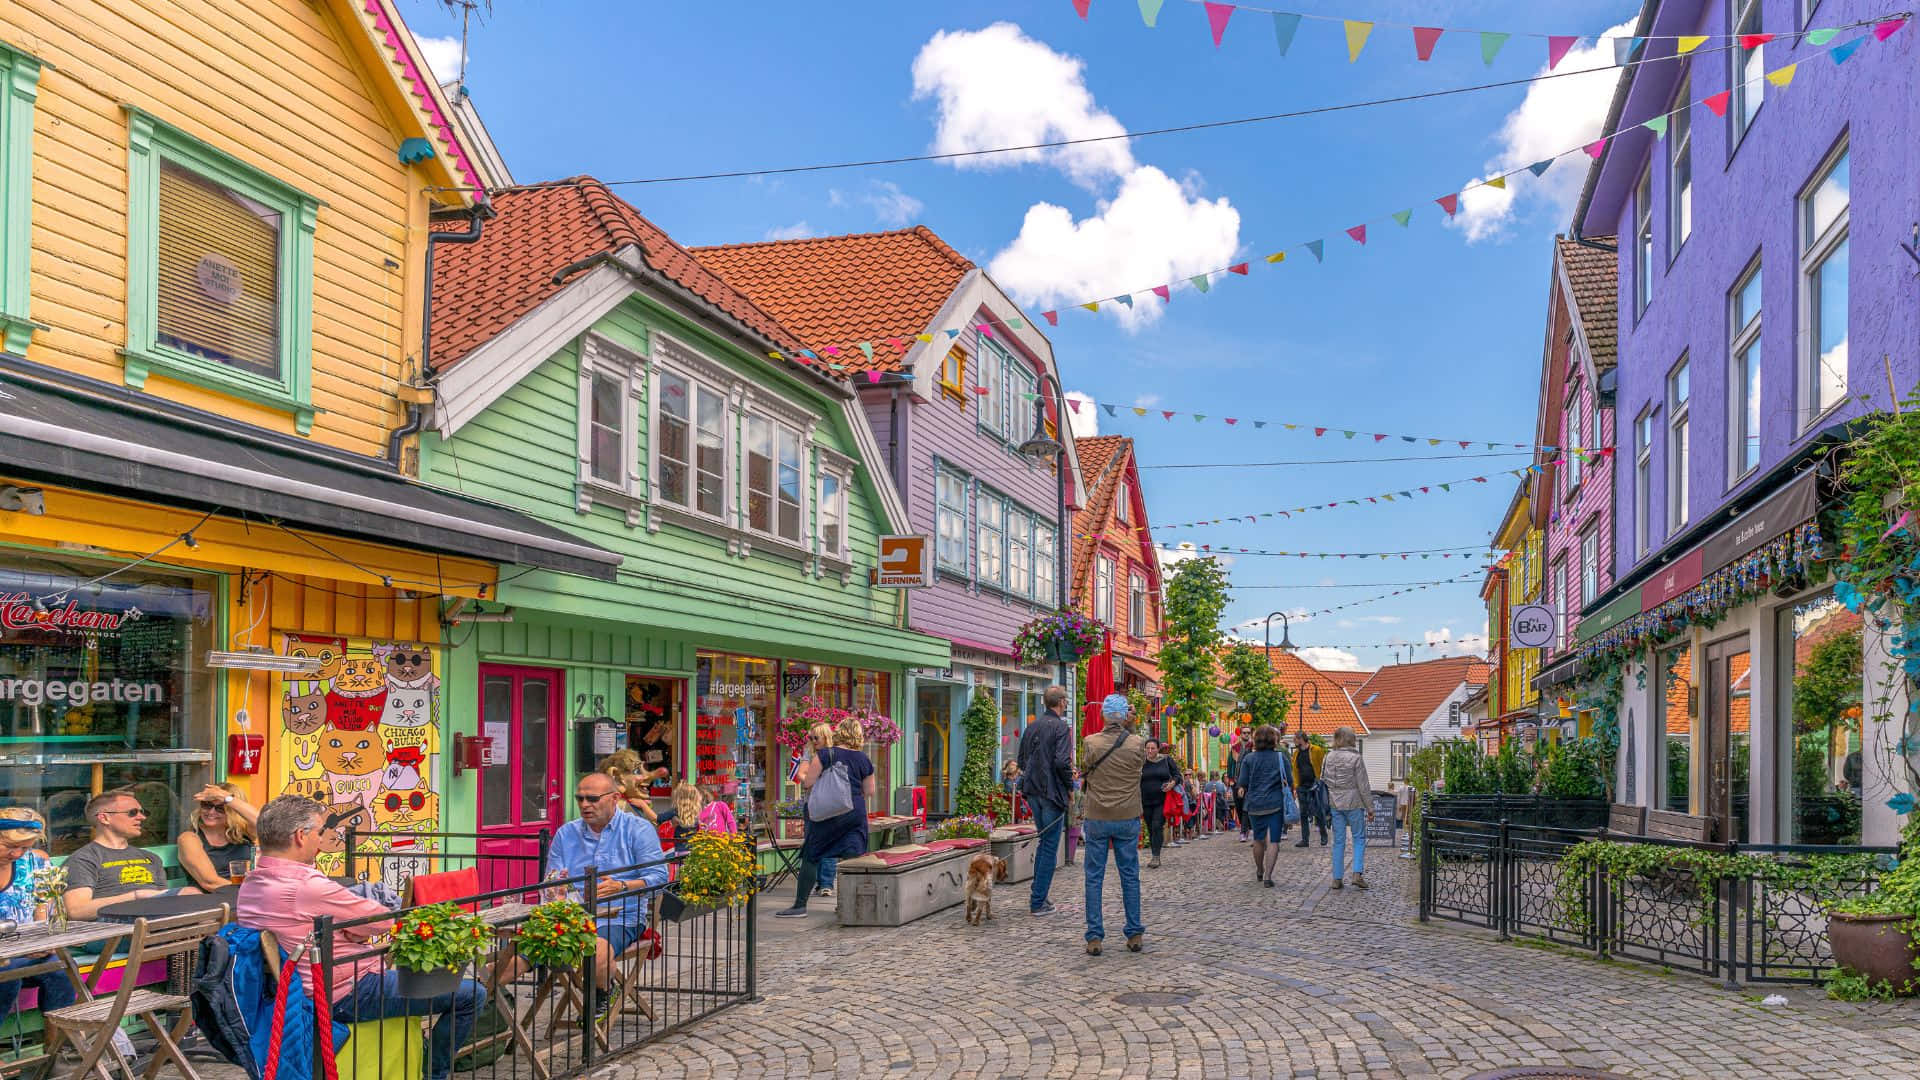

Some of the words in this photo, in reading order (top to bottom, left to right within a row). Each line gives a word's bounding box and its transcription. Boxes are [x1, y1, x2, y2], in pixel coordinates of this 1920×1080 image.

[881, 576, 922, 585] BERNINA
[1518, 620, 1548, 634] BAR
[710, 681, 766, 697] #fargegaten
[575, 692, 606, 718] 28
[384, 727, 426, 738] CHICAGO
[394, 736, 421, 746] BULLS
[335, 778, 372, 795] GUCCI
